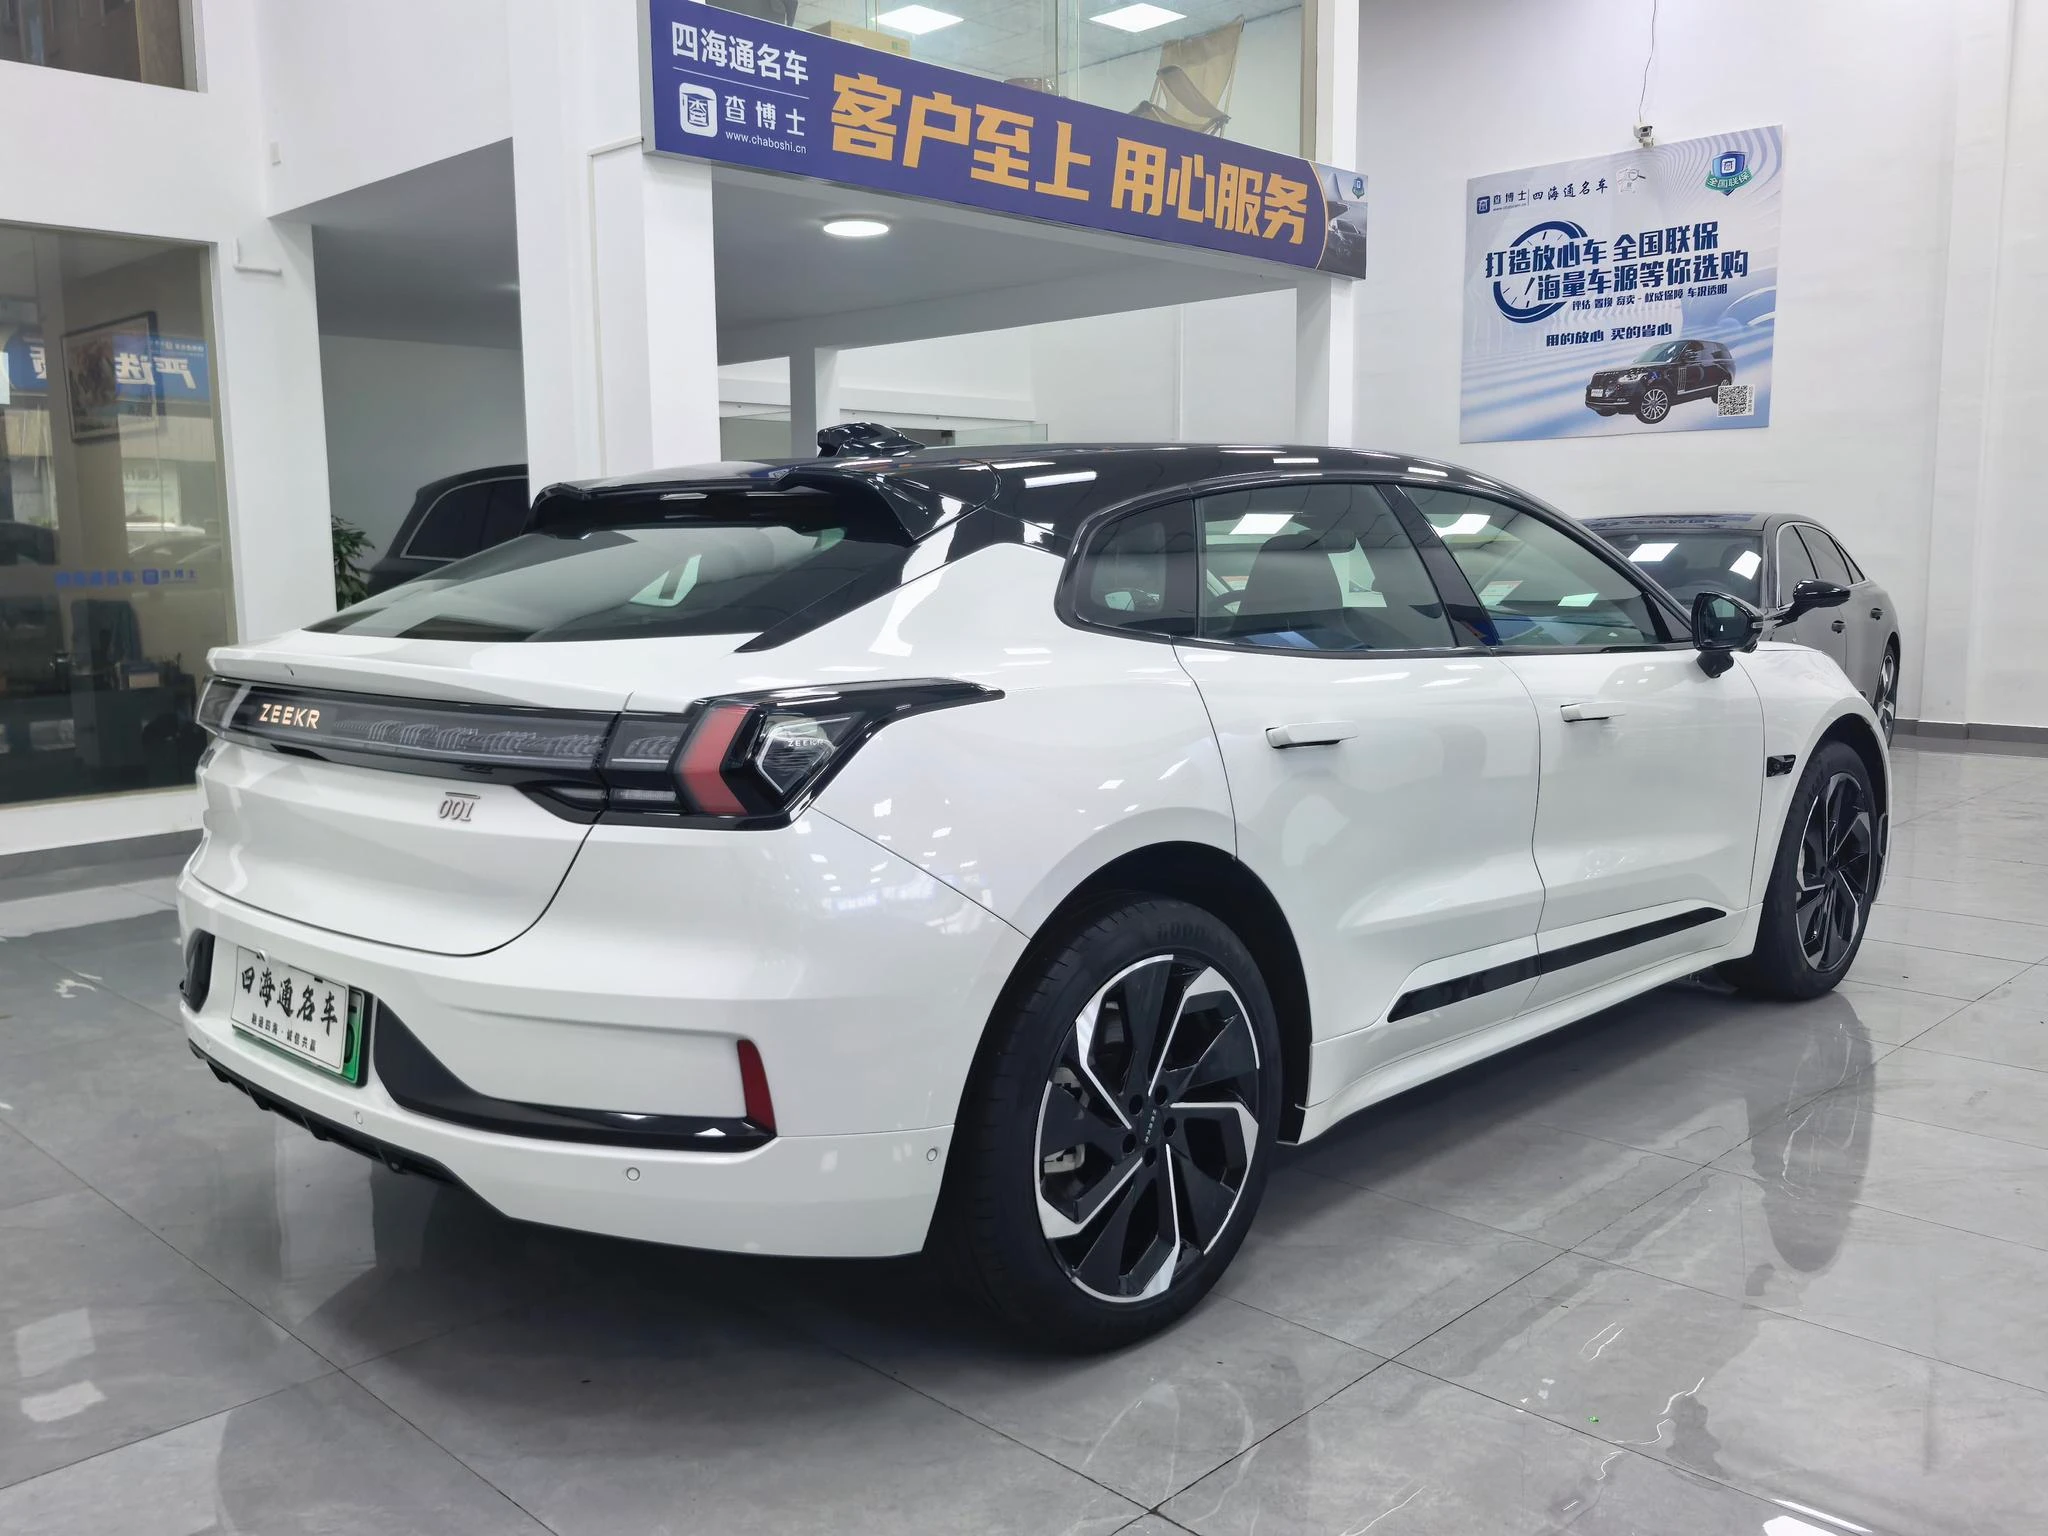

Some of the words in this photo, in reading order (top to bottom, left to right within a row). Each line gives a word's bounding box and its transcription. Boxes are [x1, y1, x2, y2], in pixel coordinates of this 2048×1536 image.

[672, 21, 809, 85] 四海通名车
[724, 95, 806, 137] 查博士
[725, 131, 807, 154] www.chaboshi.cn
[831, 72, 1091, 201] 客户至上
[1111, 137, 1308, 245] 用心服务
[1532, 178, 1608, 201] 四海通名车
[1485, 238, 1608, 278] 打造放心车
[1612, 221, 1719, 262] 全国联保
[1537, 250, 1749, 301] 海量车源等你选购
[1572, 299, 1591, 311] 评估
[1644, 288, 1684, 303] 权威保障
[1687, 284, 1728, 298] 车况透明
[1546, 329, 1604, 347] 用的放心
[1611, 322, 1673, 341] 买的省心
[259, 703, 321, 729] ZEEKR
[439, 798, 475, 822] 001
[241, 966, 338, 1037] 四海通名车
